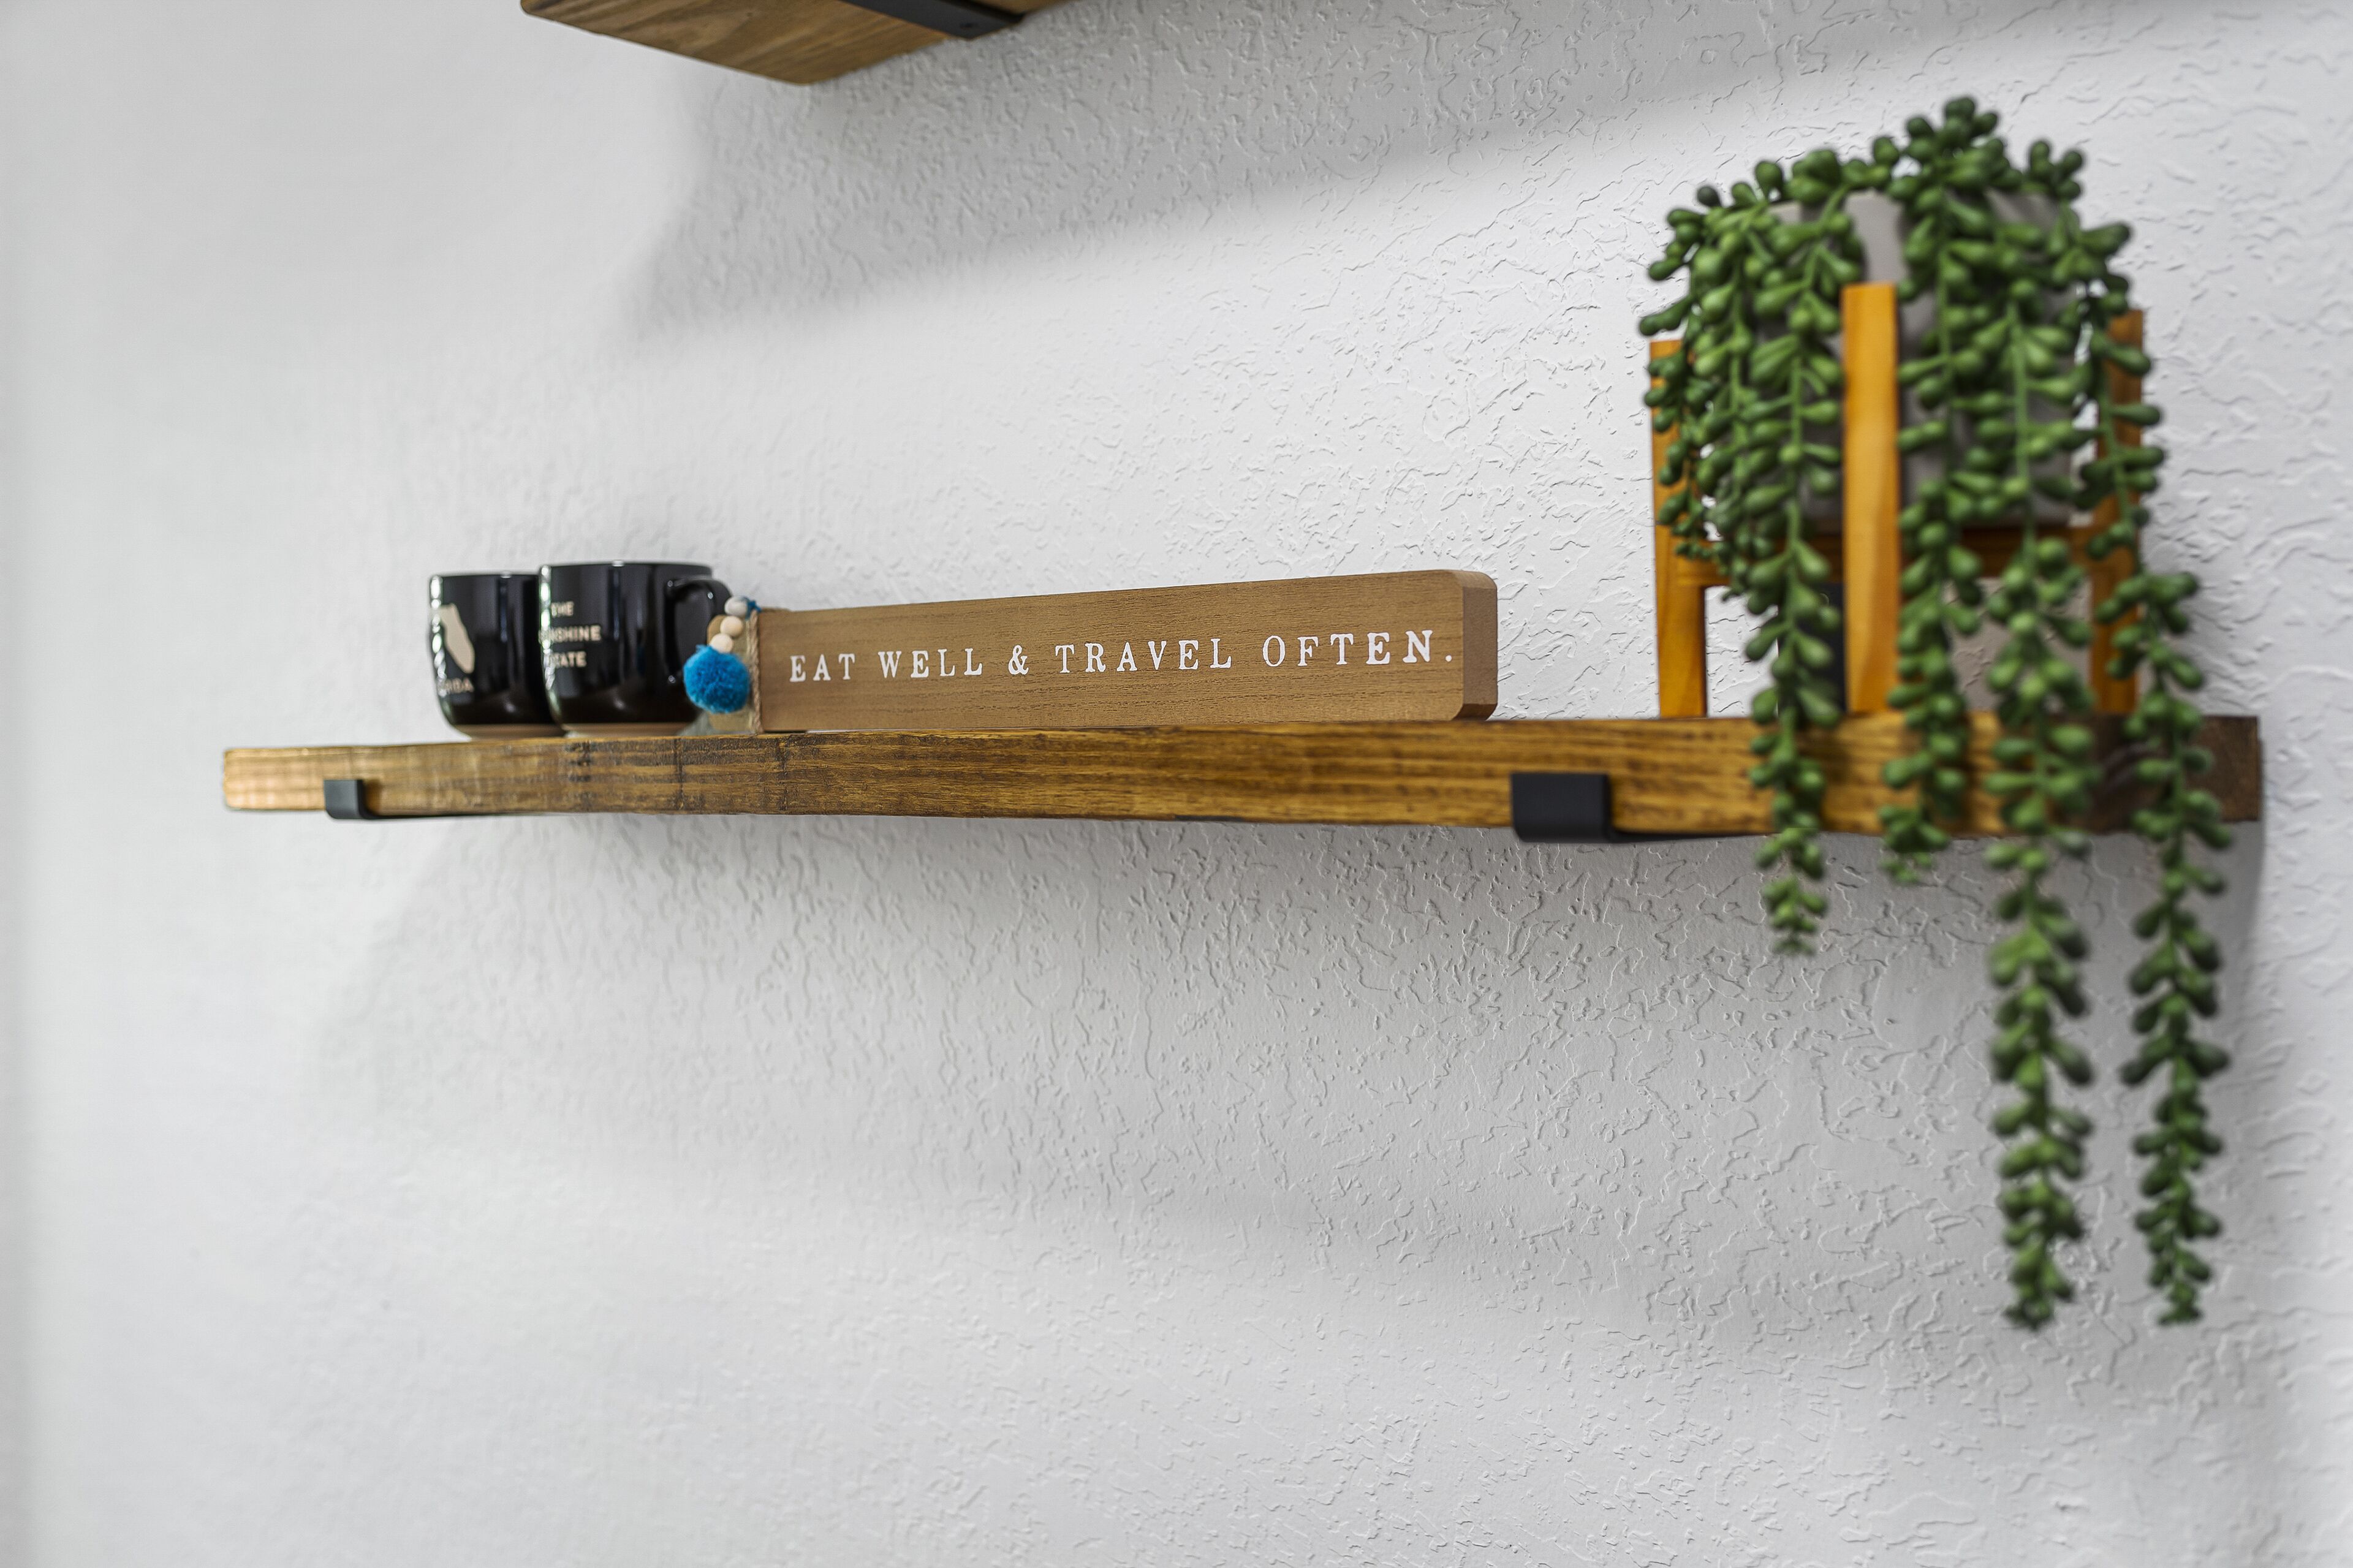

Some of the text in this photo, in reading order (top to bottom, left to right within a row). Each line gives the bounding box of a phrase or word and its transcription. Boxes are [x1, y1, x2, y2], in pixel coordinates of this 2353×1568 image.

[790, 630, 1453, 682] EAT WELL & TRAVEL OFTEN.
